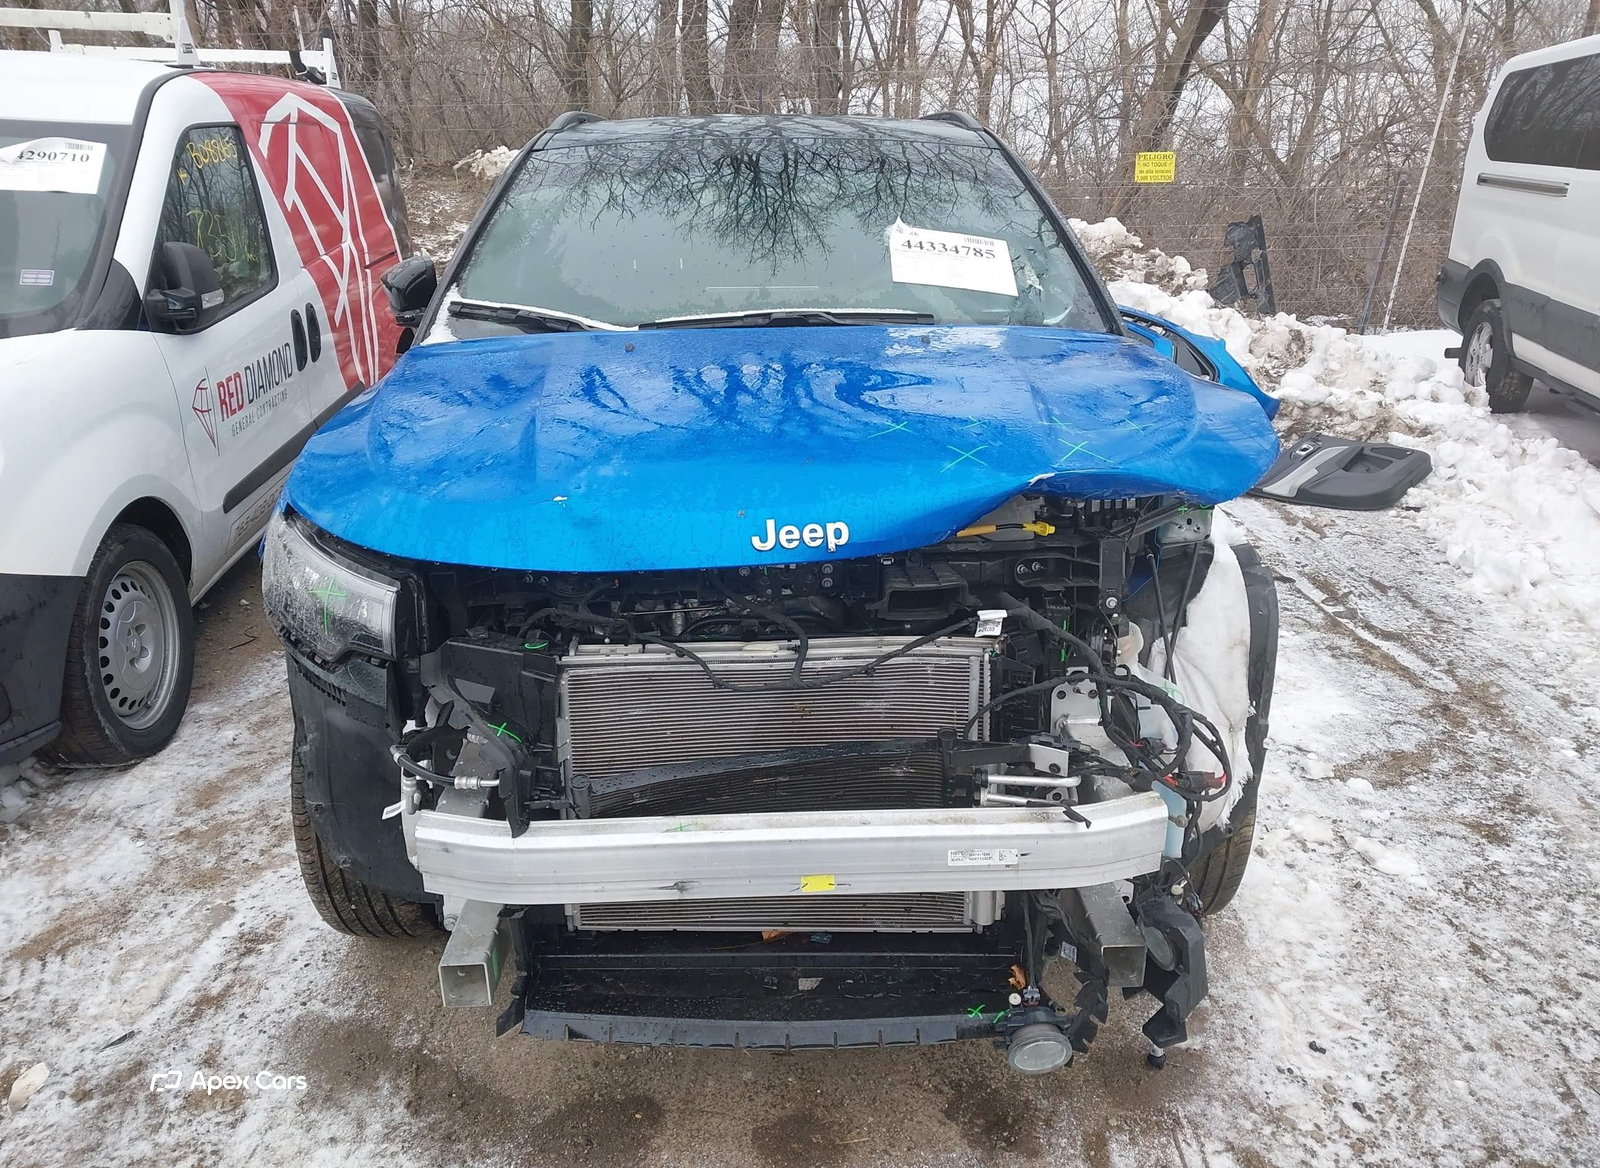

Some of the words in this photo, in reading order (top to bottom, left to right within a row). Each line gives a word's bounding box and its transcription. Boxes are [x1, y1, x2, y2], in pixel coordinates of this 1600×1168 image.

[902, 239, 996, 260] 44334785
[216, 371, 245, 422] RED
[244, 342, 293, 404] DIAMOND
[231, 413, 256, 438] GENERAL
[256, 388, 288, 421] CONTRACTING
[751, 518, 850, 552] Jeep
